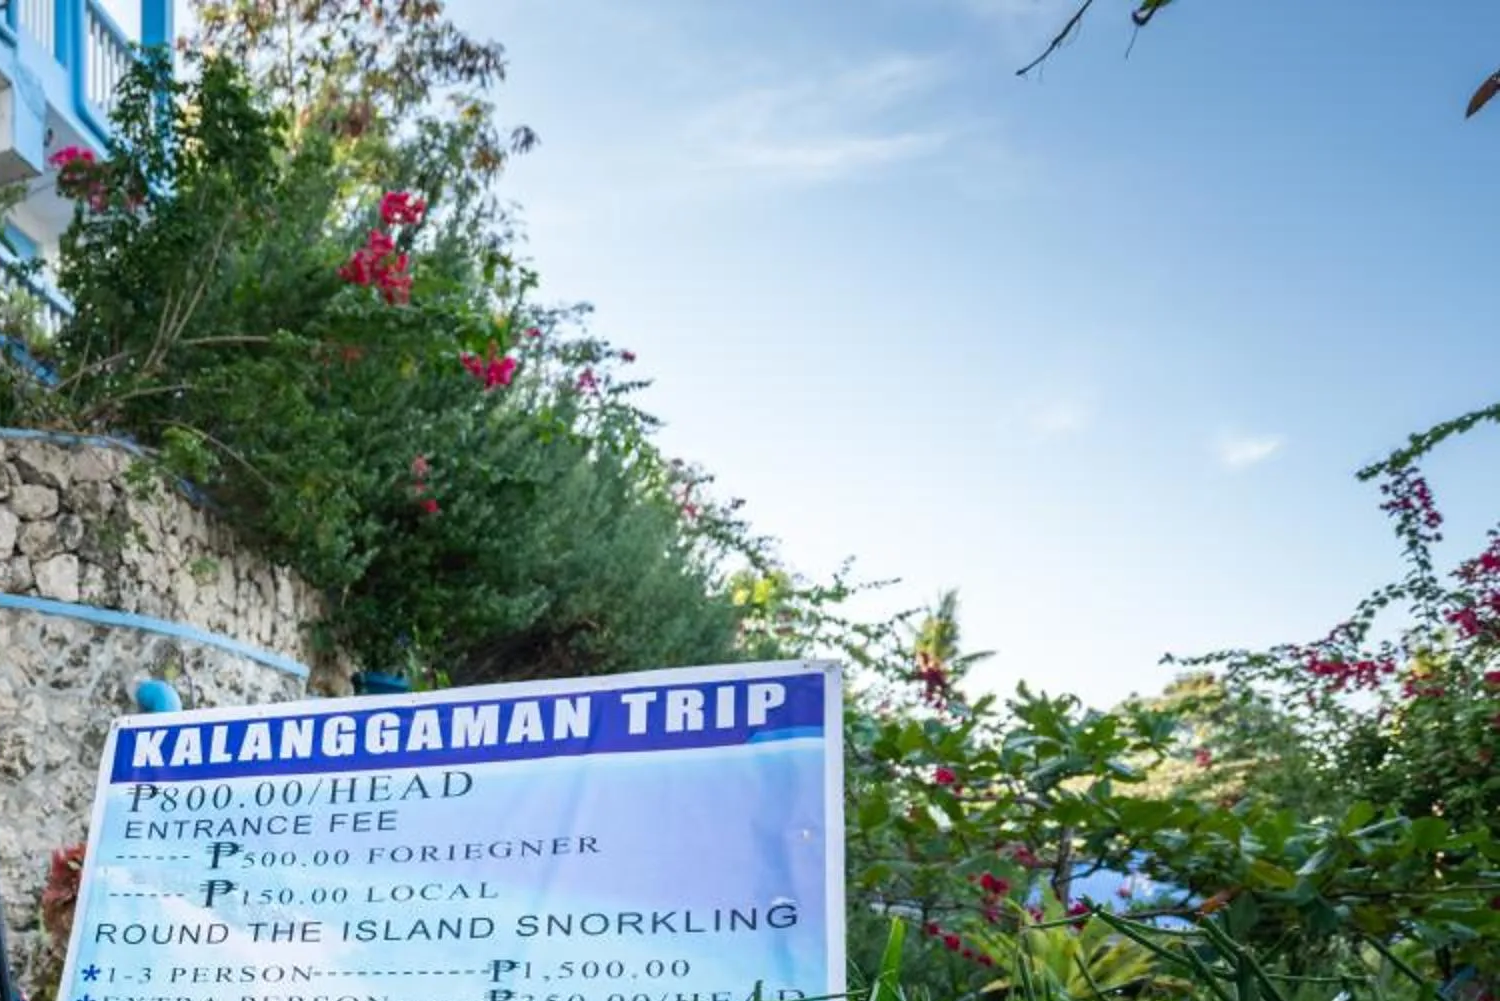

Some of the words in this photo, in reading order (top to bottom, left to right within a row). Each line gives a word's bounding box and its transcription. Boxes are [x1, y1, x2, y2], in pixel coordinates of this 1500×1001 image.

[131, 695, 591, 768] KALANGGAMAN
[621, 683, 787, 735] TRIP
[125, 815, 312, 840] ENTRANCE
[329, 810, 399, 833] FEE
[368, 836, 600, 865] FORIEGNER
[367, 881, 499, 904] LOCAL
[95, 922, 229, 945] ROUND
[247, 921, 323, 943] THE
[342, 917, 495, 942] ISLAND
[515, 904, 799, 938] SNORKLING
